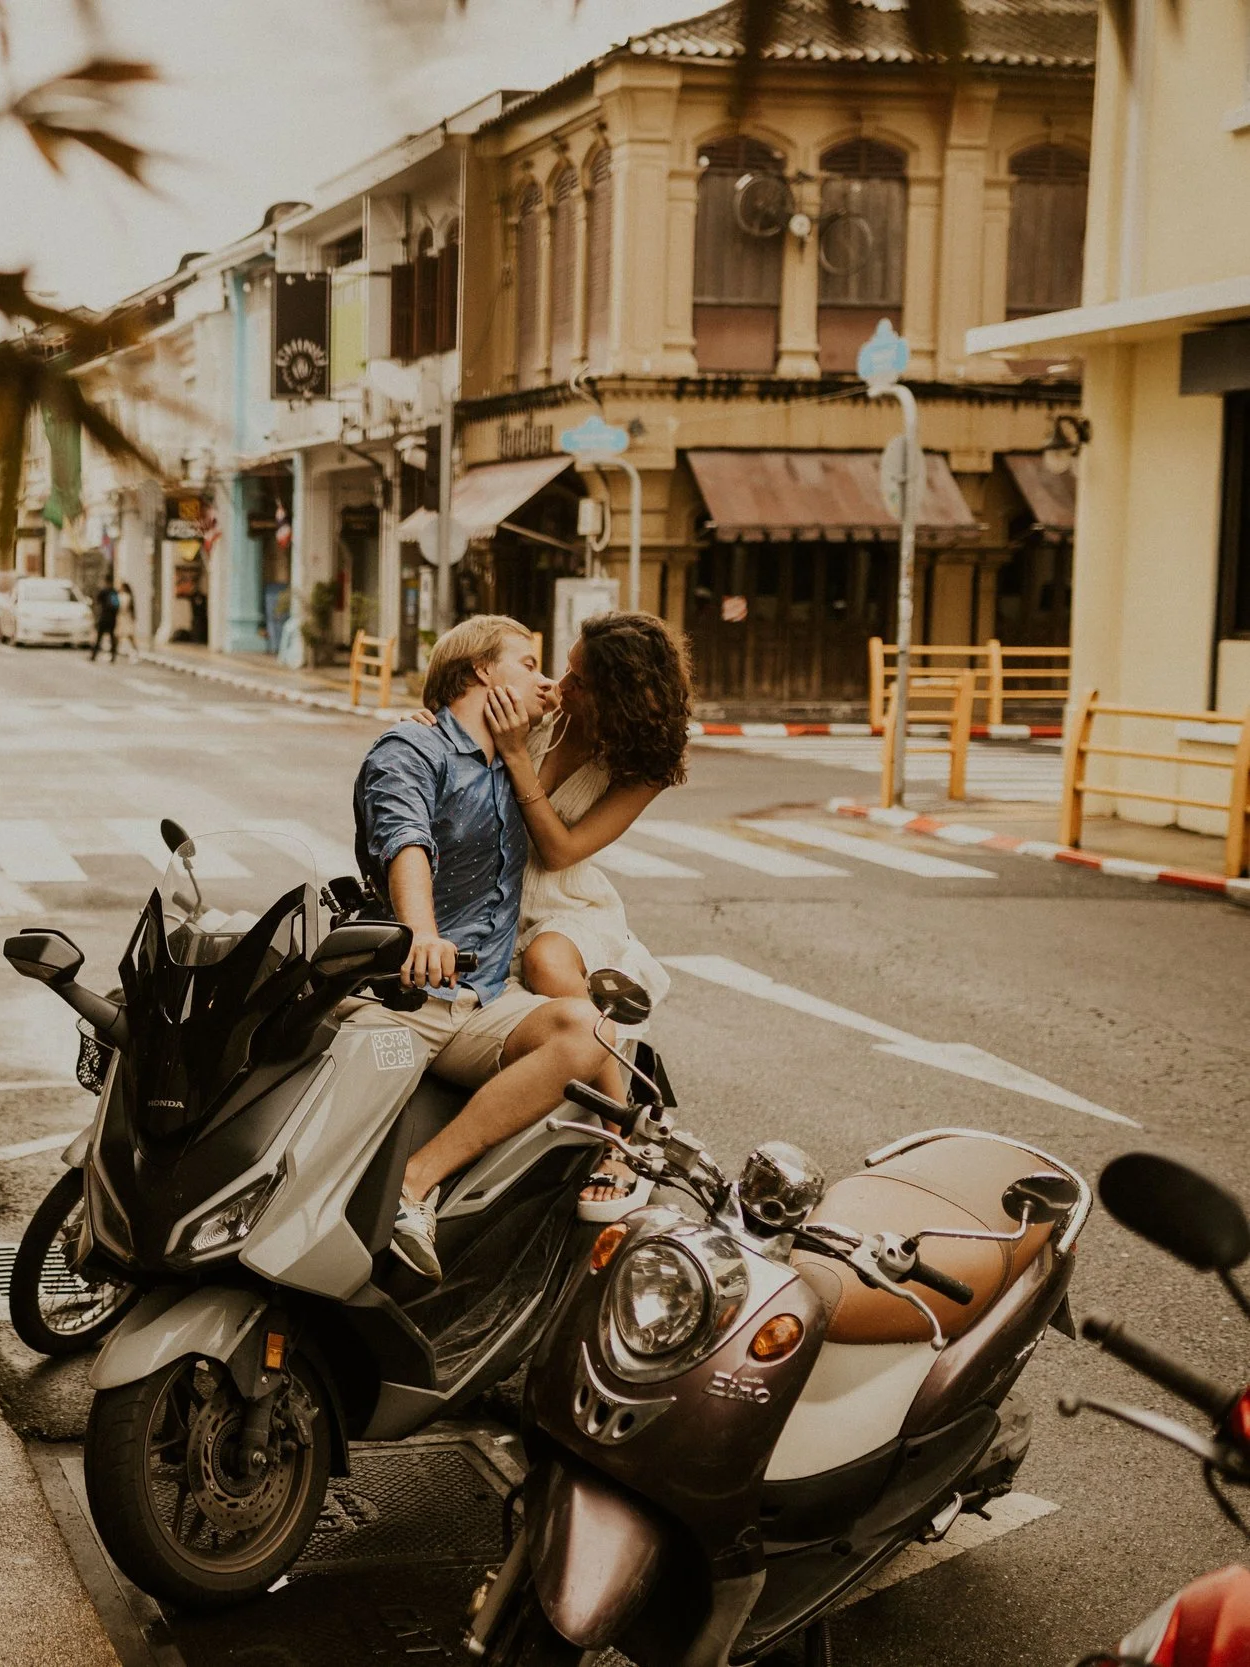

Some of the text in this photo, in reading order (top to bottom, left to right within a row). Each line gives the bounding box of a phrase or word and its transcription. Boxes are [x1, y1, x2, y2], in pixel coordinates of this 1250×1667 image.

[373, 1031, 410, 1050] BORN
[380, 1048, 412, 1067] TO BE
[147, 1099, 185, 1109] HONDA
